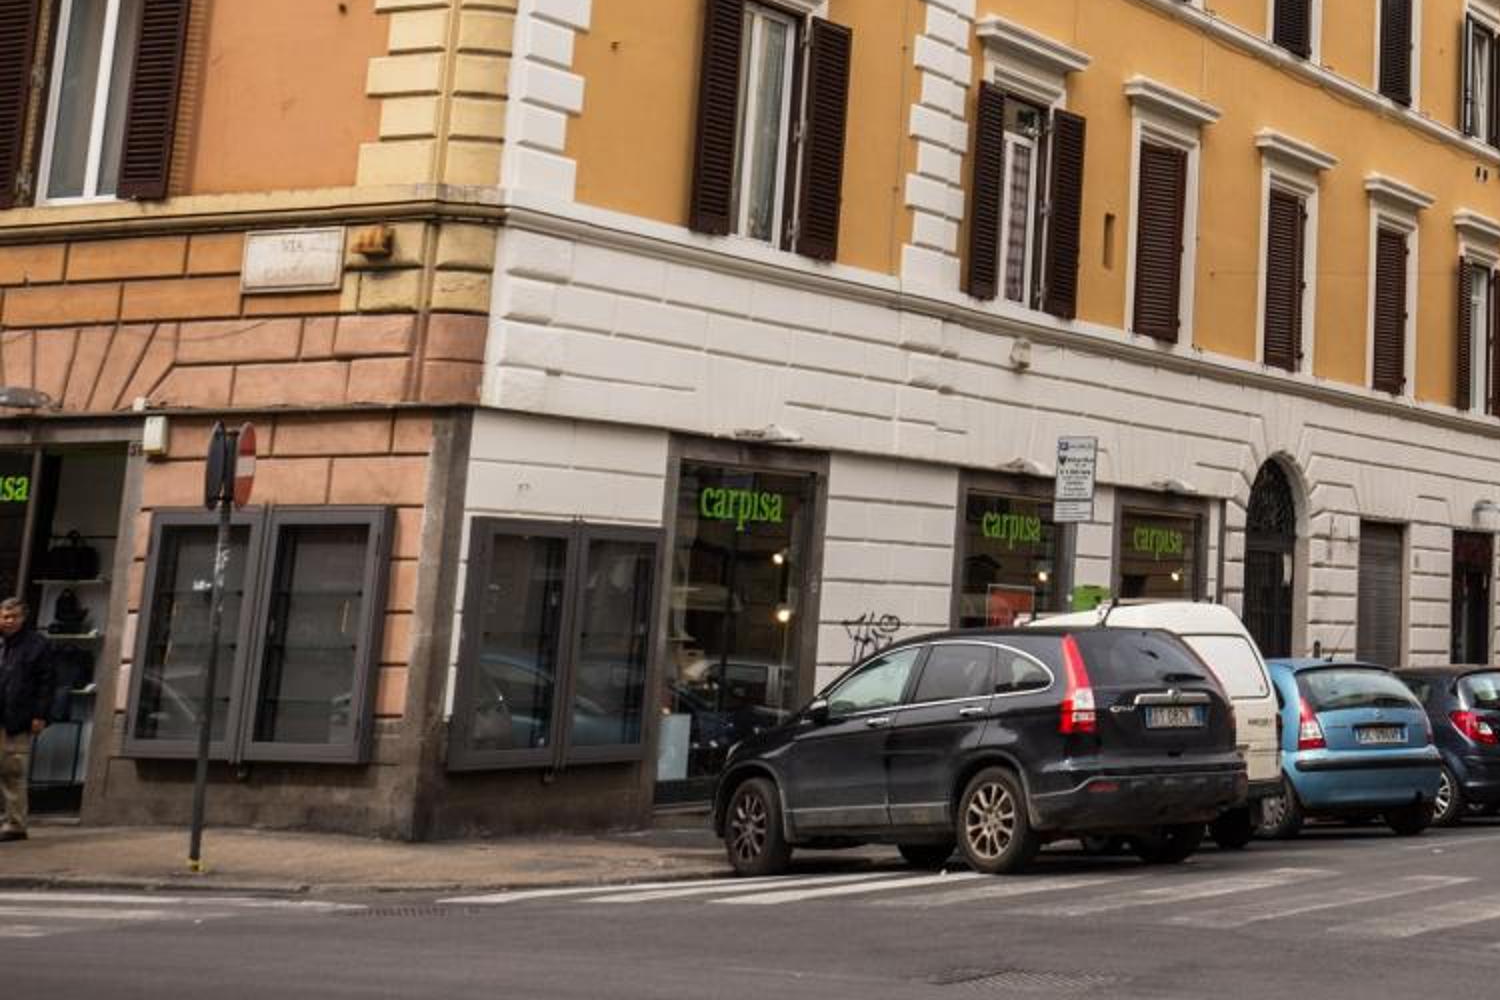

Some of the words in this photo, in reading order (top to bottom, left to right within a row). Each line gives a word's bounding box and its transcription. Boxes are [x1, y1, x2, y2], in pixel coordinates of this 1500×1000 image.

[702, 487, 783, 532] carpisa
[982, 512, 1041, 550] carpisa
[1133, 527, 1184, 560] carpisa
